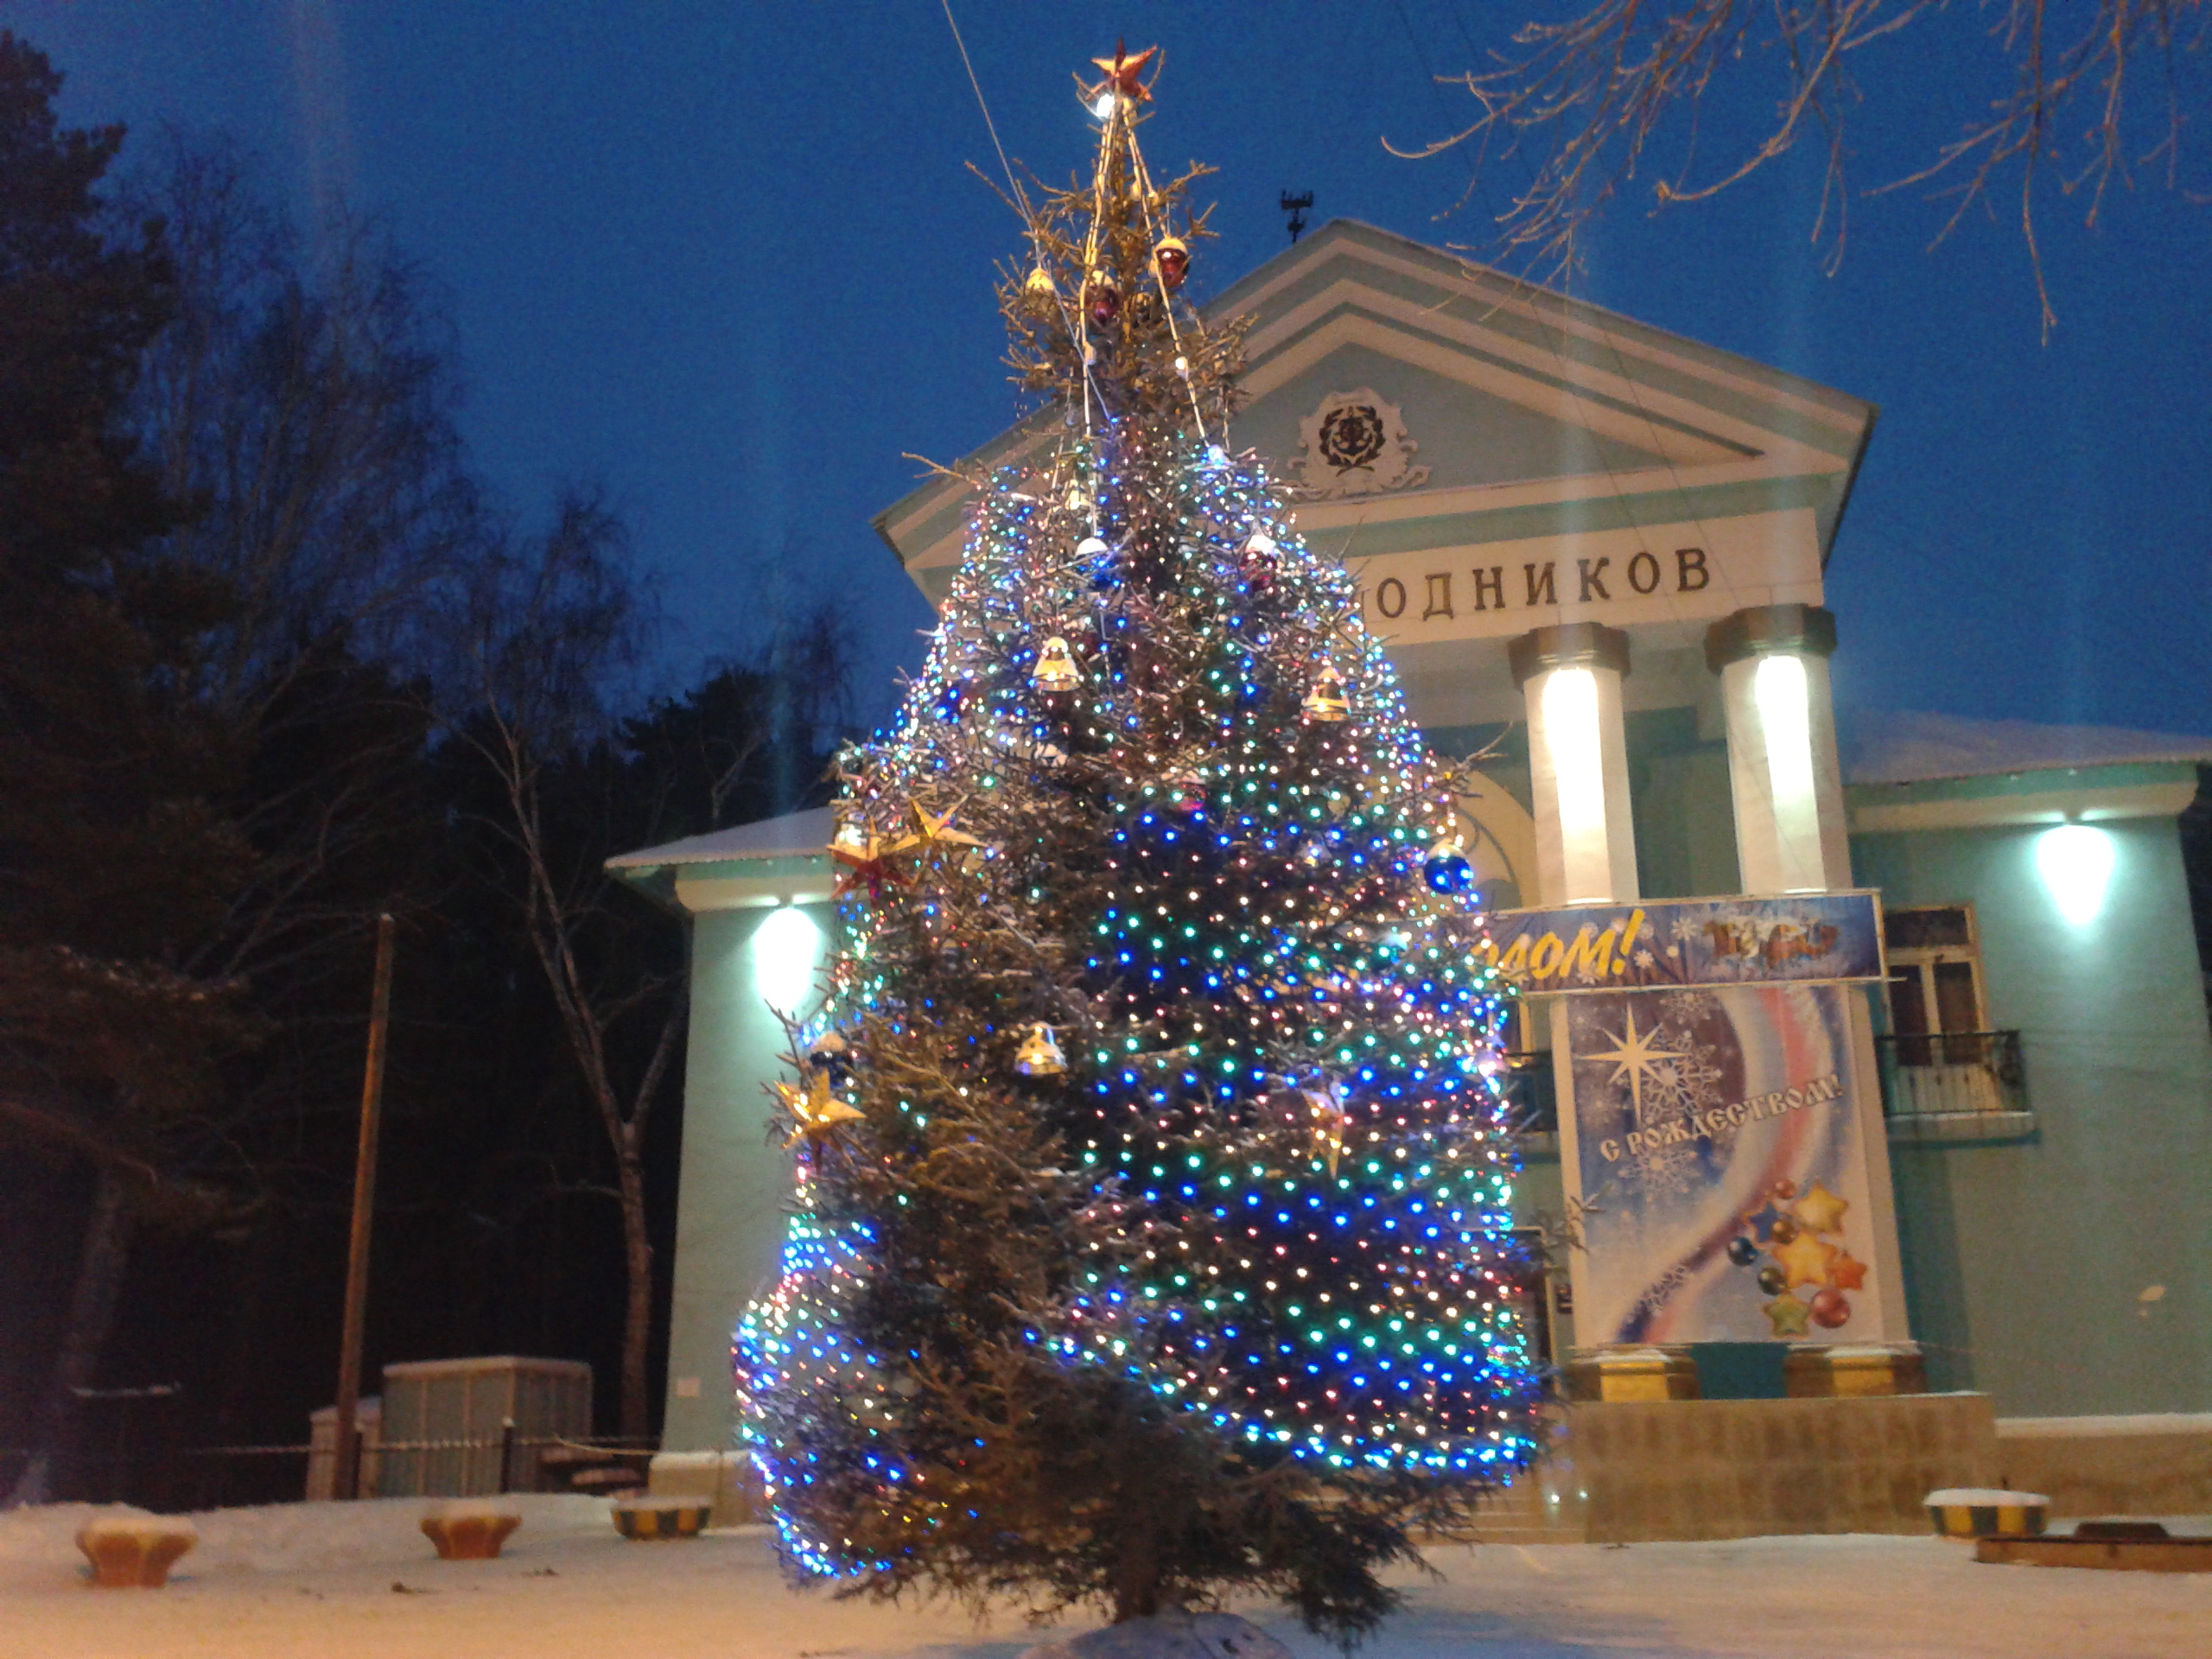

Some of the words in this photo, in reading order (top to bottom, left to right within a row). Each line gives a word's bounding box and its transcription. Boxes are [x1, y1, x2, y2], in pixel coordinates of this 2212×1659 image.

[1376, 547, 1710, 621] ОДНИКОВ
[1599, 1138, 1621, 1162] С
[1626, 1074, 1843, 1155] РОЖДЕСТВОМ!
